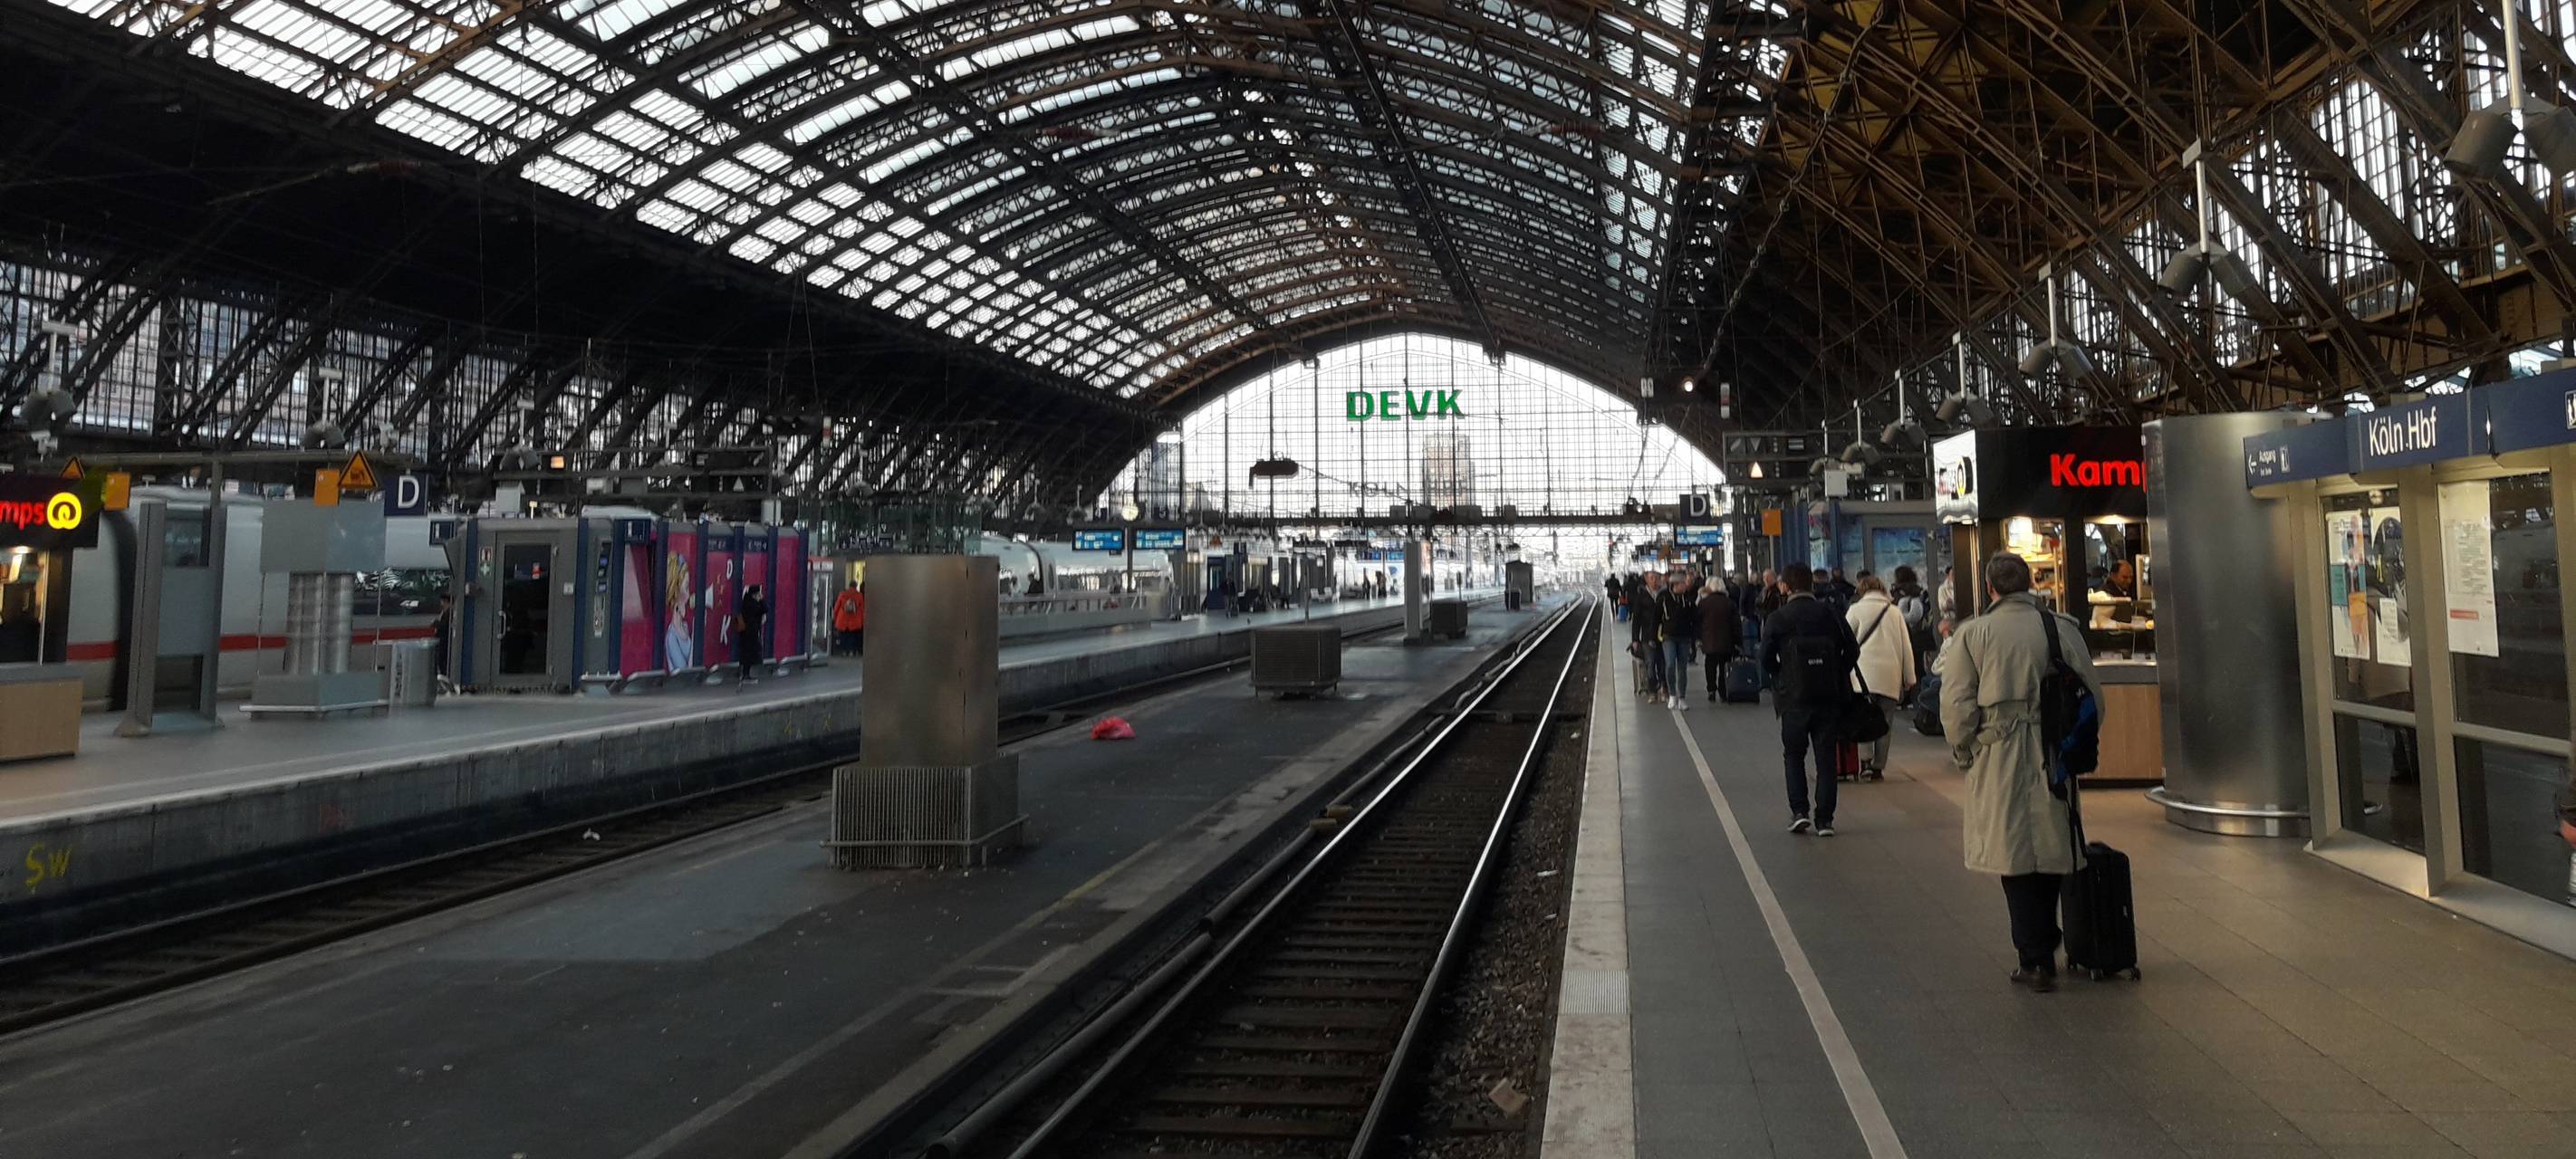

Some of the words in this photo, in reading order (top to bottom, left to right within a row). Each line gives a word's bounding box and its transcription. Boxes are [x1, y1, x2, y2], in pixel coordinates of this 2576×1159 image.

[1347, 389, 1465, 421] DEVK
[2369, 416, 2403, 457] Köln
[2408, 406, 2437, 451] Hbf
[398, 475, 419, 509] D
[1689, 493, 1707, 517] D
